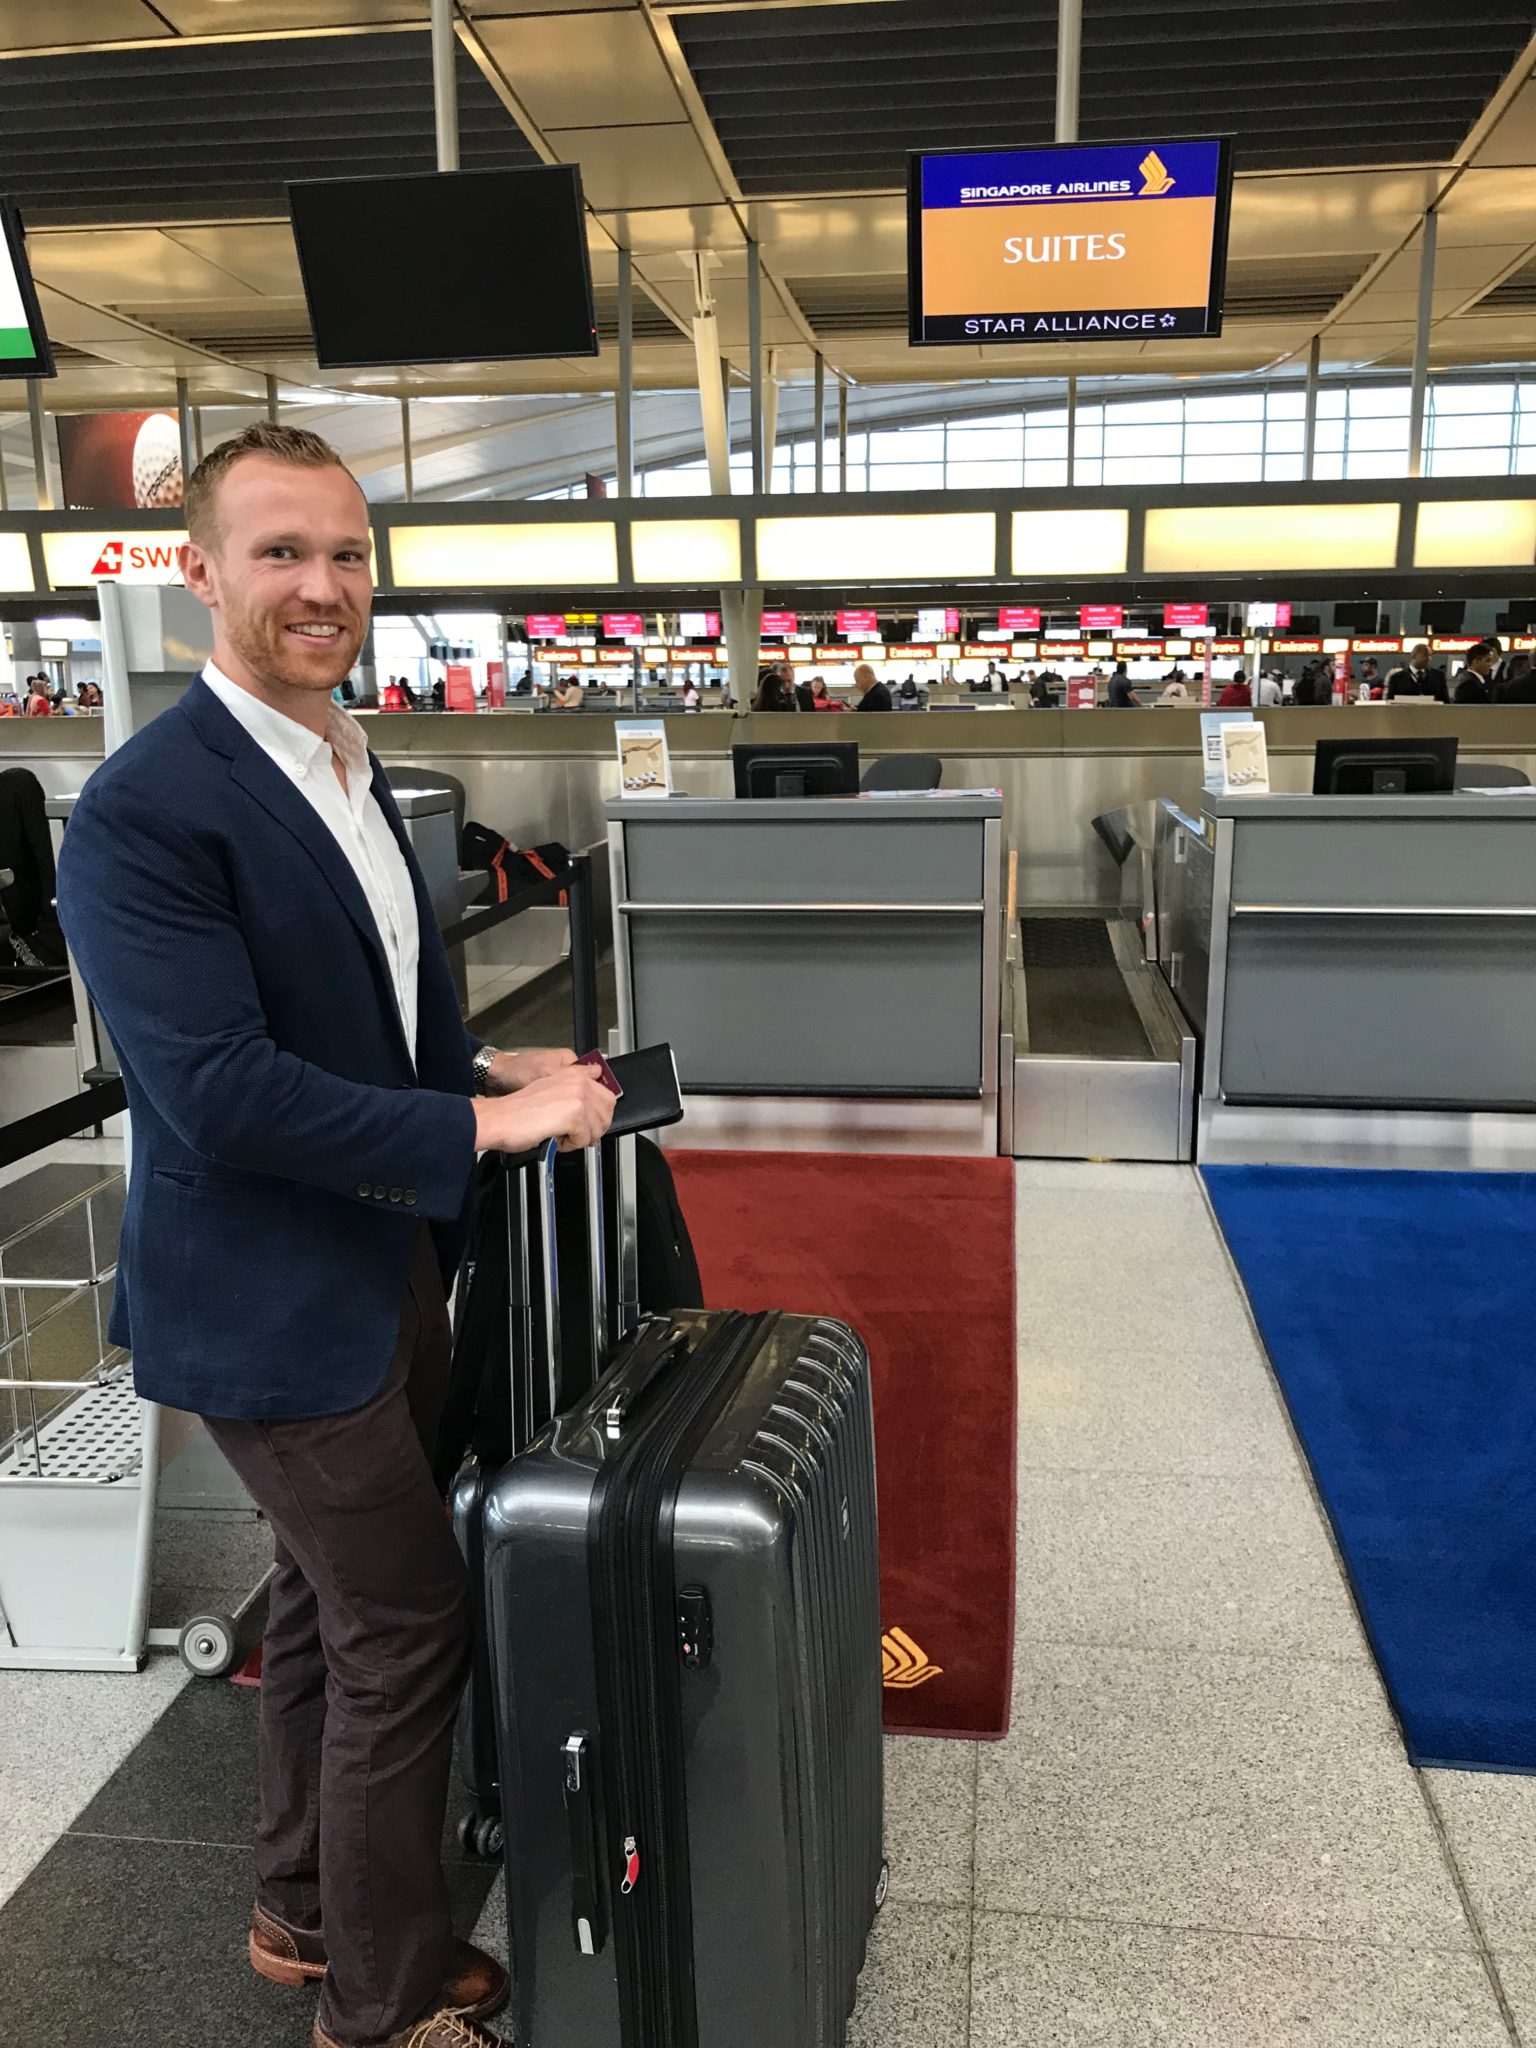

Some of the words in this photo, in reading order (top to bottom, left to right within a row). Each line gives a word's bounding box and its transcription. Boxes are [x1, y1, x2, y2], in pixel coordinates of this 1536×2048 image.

[960, 184, 1052, 198] SINGAPORE
[1056, 180, 1131, 194] AIRLINES
[1003, 233, 1127, 264] SUITES
[964, 318, 1025, 334] STAR
[1034, 314, 1156, 332] ALLIANCE
